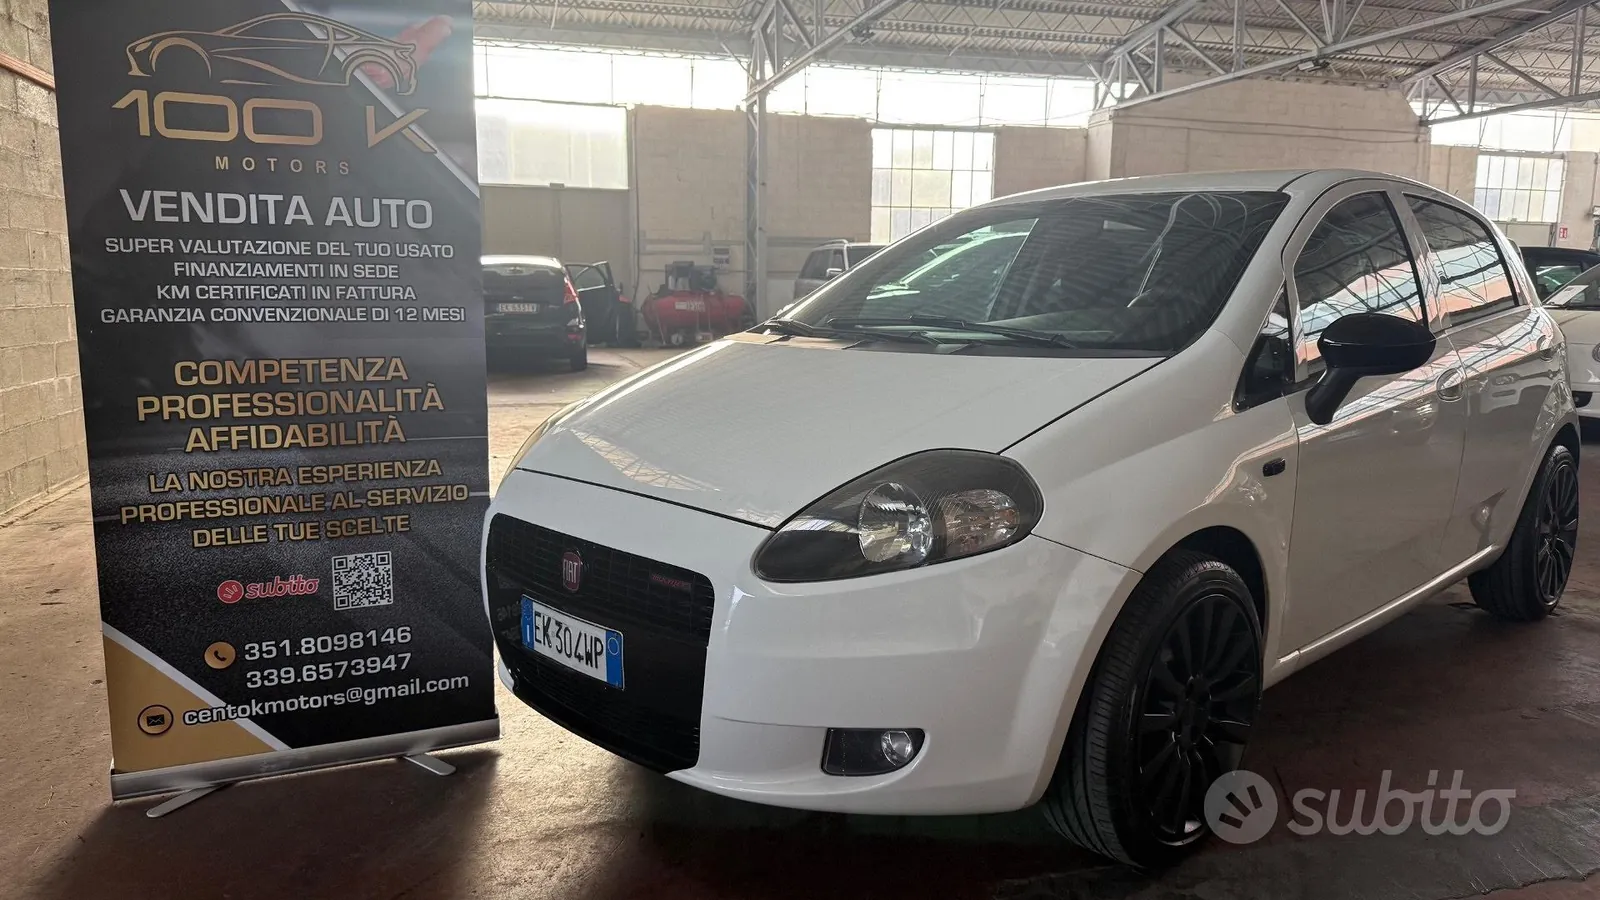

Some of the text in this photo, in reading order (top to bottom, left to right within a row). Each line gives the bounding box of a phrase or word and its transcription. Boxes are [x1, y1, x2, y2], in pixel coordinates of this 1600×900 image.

[112, 89, 437, 154] 100 K
[215, 156, 350, 175] MOTORS
[119, 188, 433, 230] VENDITA AUTO
[105, 237, 454, 259] SUPER VALUTAZIONE DEL TUO USATO
[174, 262, 399, 279] FINANZIAMENTI IN SEDE
[156, 284, 416, 301] KM CERTIFICATI IN FATTURA
[101, 307, 465, 324] GARANZIA CONVENZIONALE DI 12 MESI
[174, 357, 409, 387] COMPETENZA
[136, 383, 445, 421] PROFESSIONALITÀ
[184, 415, 406, 453] AFFIDABILITÀ
[148, 459, 442, 494] LA NOSTRA ESPERIENZA
[120, 484, 469, 525] PROFESSIONALE AL SERVIZIO
[192, 514, 410, 549] DELLE TUE SCELTE
[245, 575, 319, 599] subito
[562, 558, 578, 583] FIAT
[244, 626, 412, 661] 351.8098146
[246, 652, 412, 689] 339.6573947
[183, 673, 469, 726] centokmotors@gmail.com
